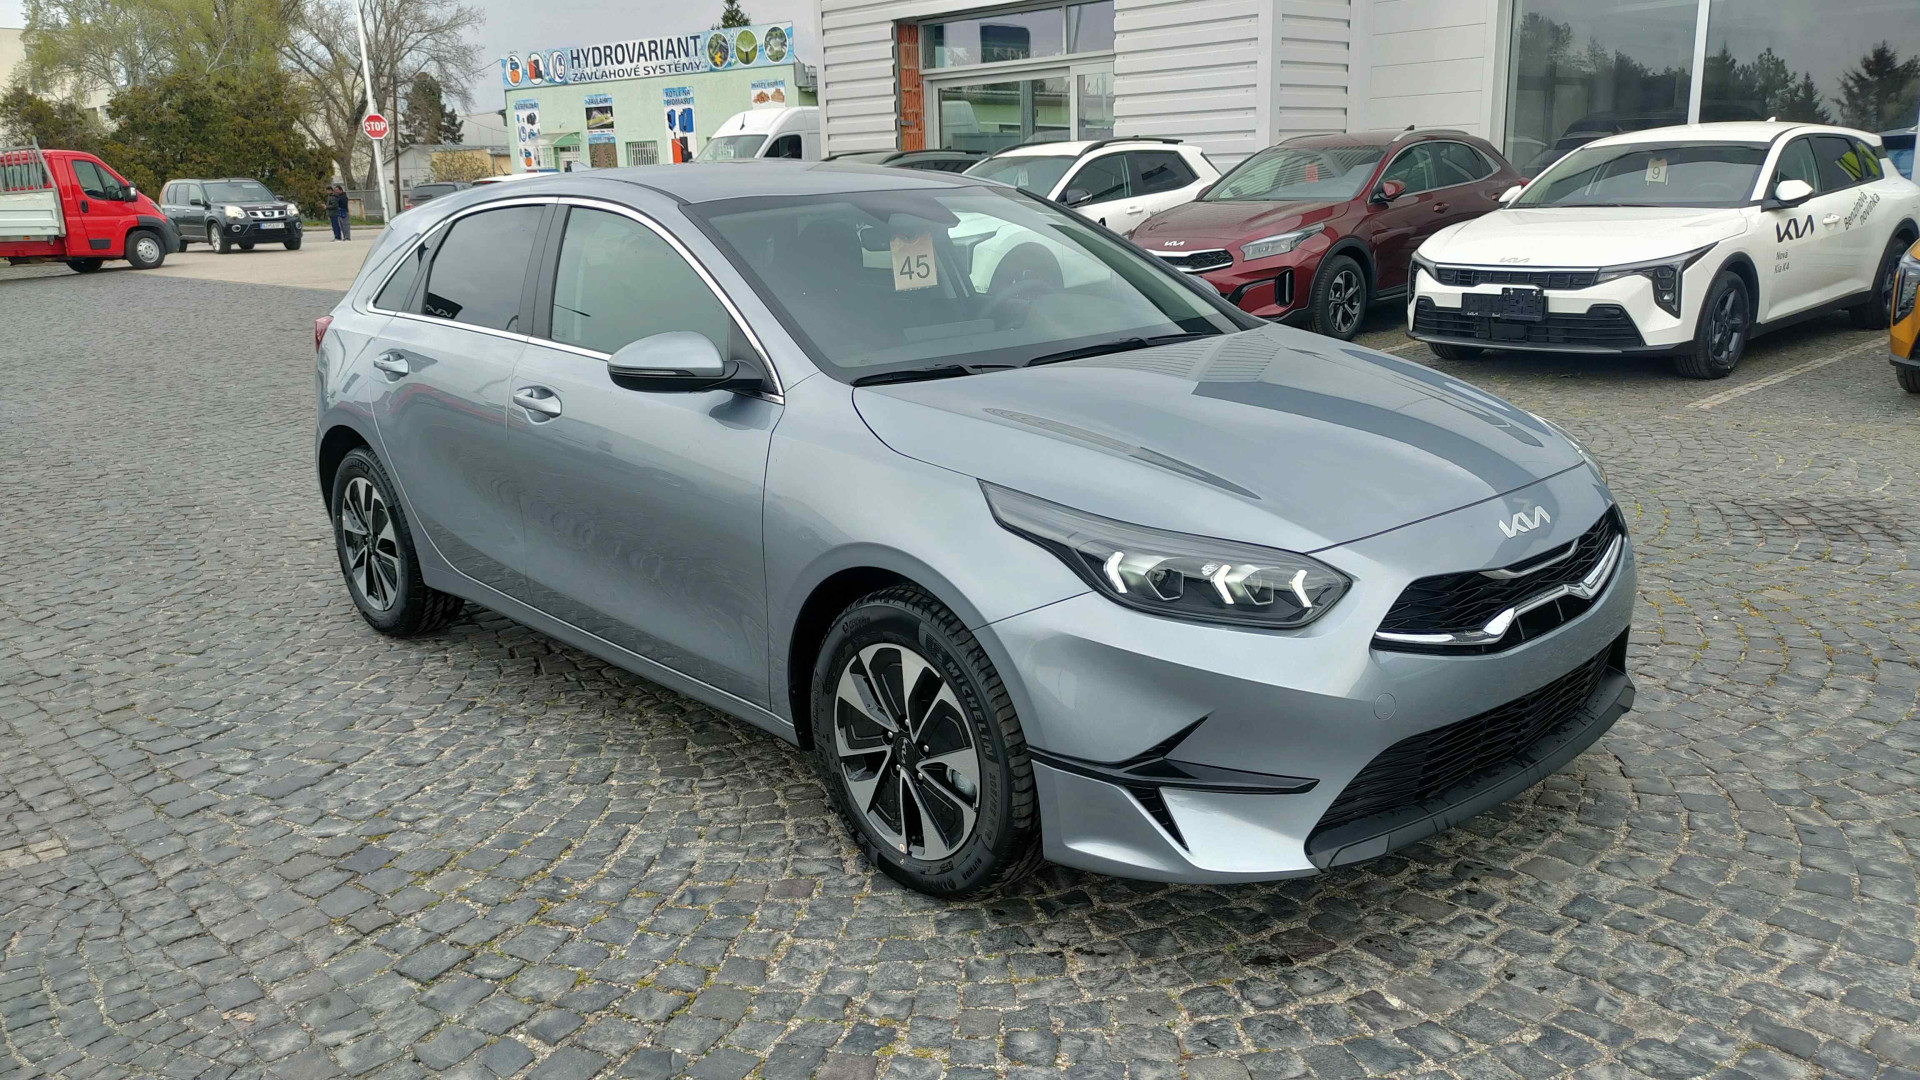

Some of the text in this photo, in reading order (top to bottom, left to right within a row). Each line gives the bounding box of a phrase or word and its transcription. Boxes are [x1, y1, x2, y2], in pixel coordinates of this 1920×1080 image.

[570, 34, 701, 70] HYDROVARIANT
[643, 60, 702, 76] SYSTÉMY
[365, 121, 386, 132] STOP
[1652, 166, 1661, 180] 9
[1860, 192, 1881, 226] novinka
[1775, 214, 1815, 244] KIA
[899, 253, 931, 281] 45
[1498, 505, 1551, 539] KIA
[946, 661, 994, 757] MICHELIN
